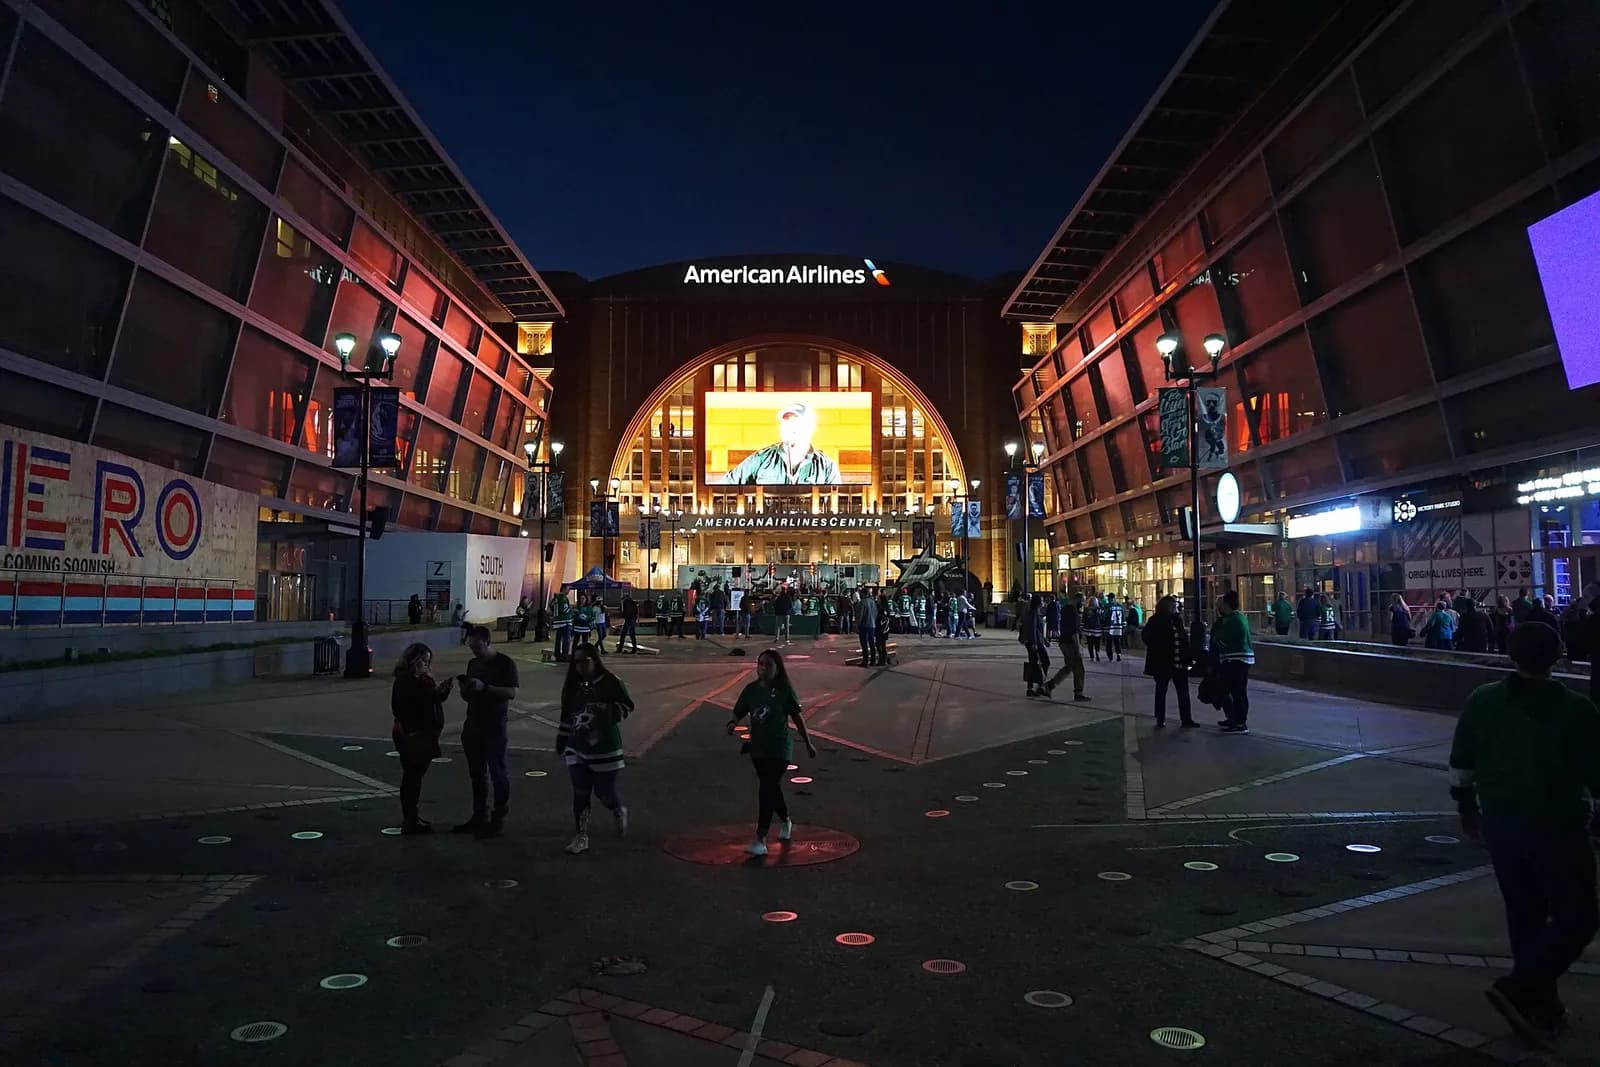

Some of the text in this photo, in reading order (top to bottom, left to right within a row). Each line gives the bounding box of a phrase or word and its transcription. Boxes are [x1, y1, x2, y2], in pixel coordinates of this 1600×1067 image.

[683, 265, 866, 285] American Airlines
[4, 553, 116, 574] COMING SOONISH
[433, 562, 444, 576] Z
[480, 555, 504, 576] SOUTH
[1408, 568, 1441, 580] ORIGINAL
[1441, 568, 1462, 578] LIVES
[475, 580, 507, 601] VICTORY
